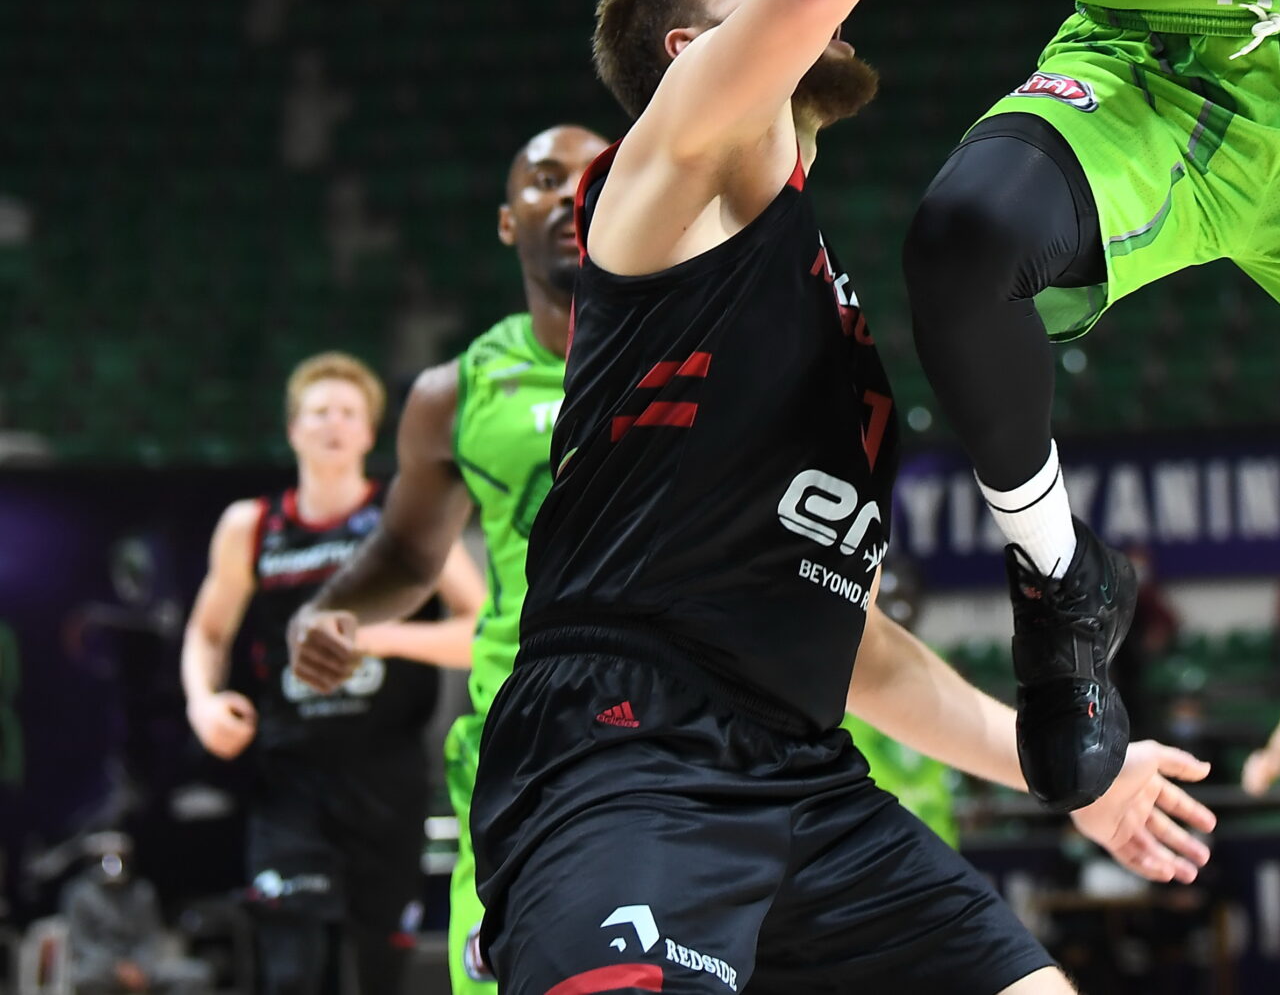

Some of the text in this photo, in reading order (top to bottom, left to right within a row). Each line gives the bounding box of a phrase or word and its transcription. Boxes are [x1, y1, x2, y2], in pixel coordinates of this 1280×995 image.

[1022, 75, 1084, 97] FIAT
[799, 558, 863, 606] BEYOND
[596, 713, 640, 729] adidas
[664, 937, 738, 992] REDSIDE
